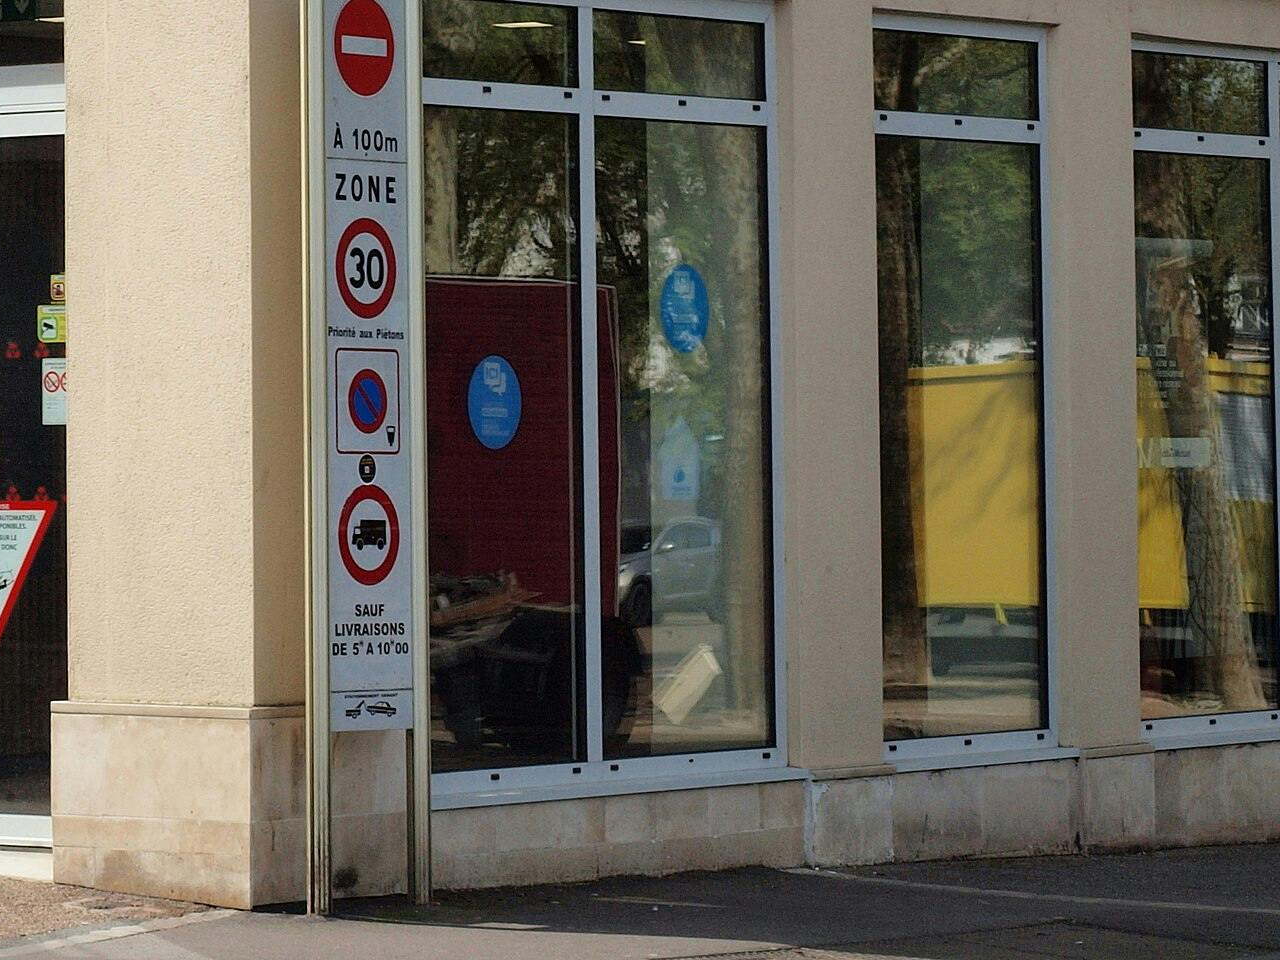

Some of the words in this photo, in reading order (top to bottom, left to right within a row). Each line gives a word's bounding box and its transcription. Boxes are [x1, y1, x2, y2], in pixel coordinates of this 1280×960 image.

[334, 122, 343, 149] À
[353, 129, 398, 152] 100m
[335, 173, 396, 203] ZONE
[350, 247, 384, 289] 30
[328, 326, 356, 338] Priorité
[359, 329, 373, 338] aux
[355, 604, 385, 617] SAUF
[335, 622, 405, 636] LIVRAISONS
[332, 643, 347, 656] DE
